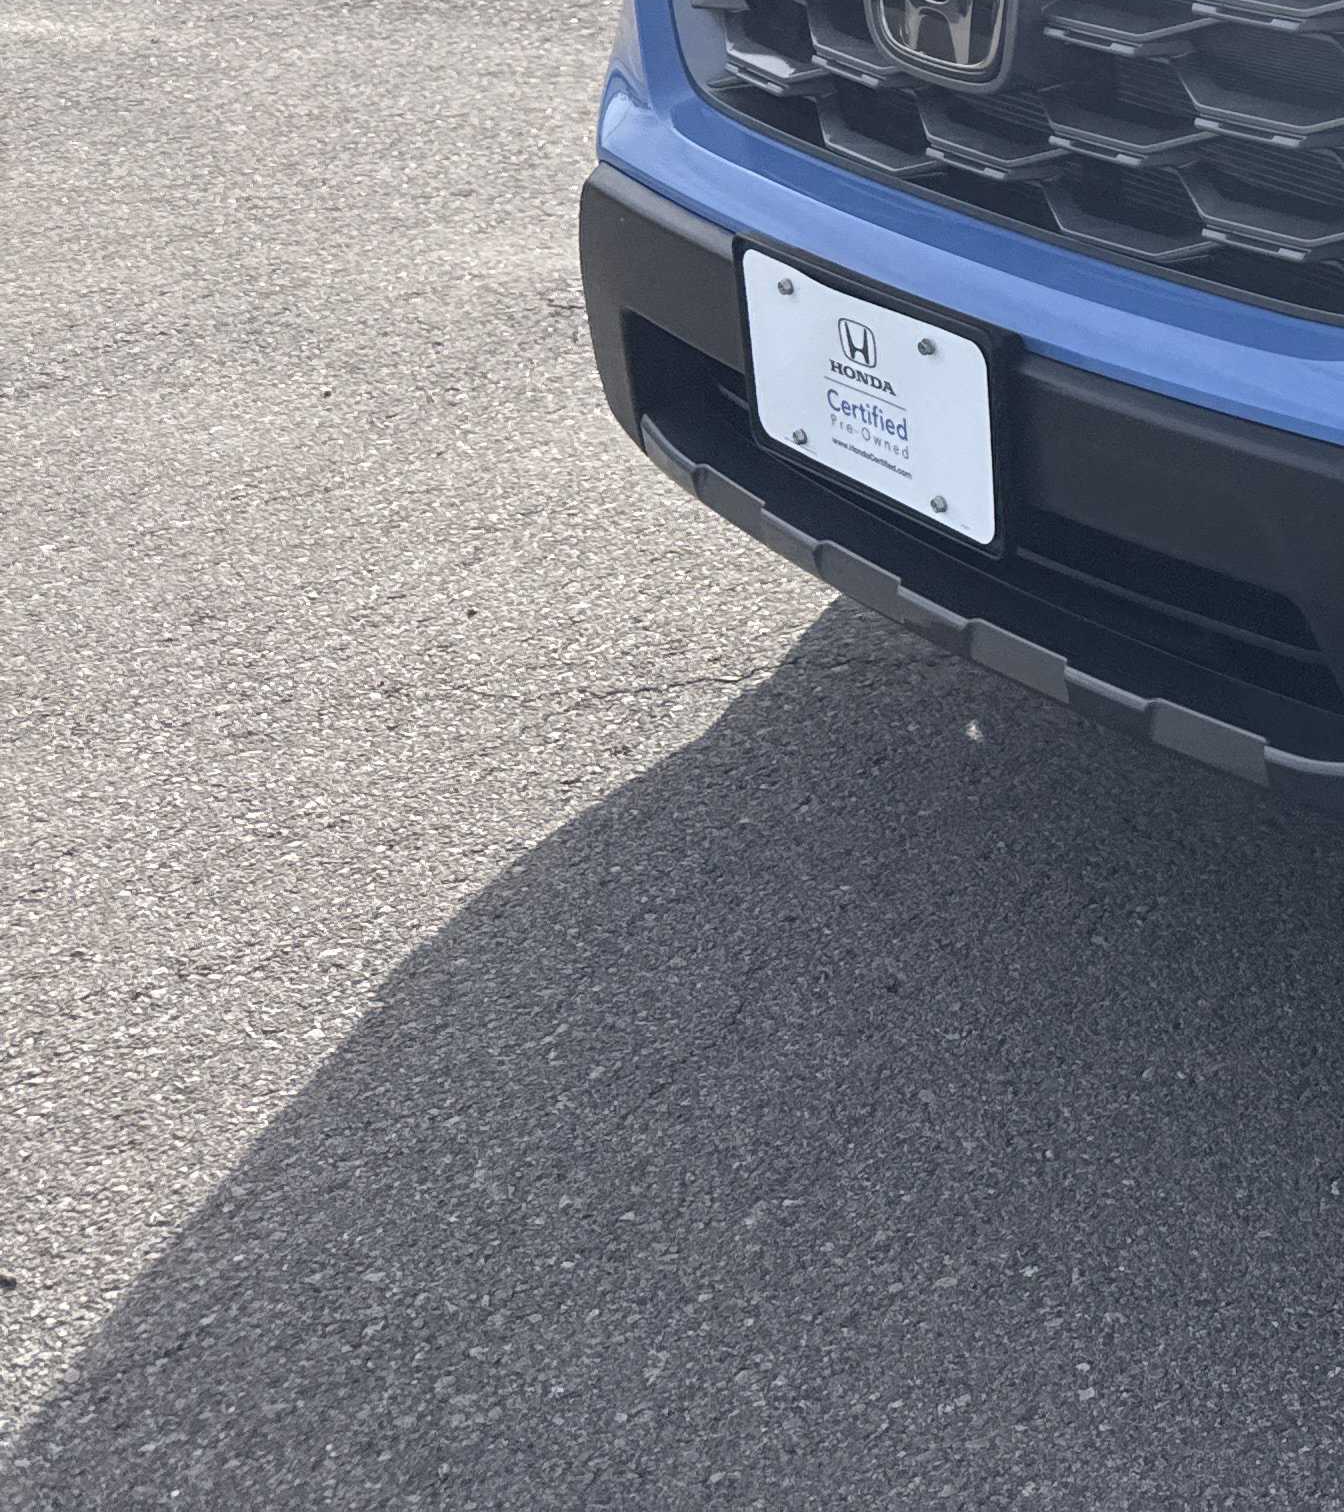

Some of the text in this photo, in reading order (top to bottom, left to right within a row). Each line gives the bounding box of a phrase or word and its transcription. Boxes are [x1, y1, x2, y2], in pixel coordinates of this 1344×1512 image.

[829, 359, 896, 396] HONDA
[827, 389, 908, 441] Certified
[830, 413, 909, 460] Pre-Owned
